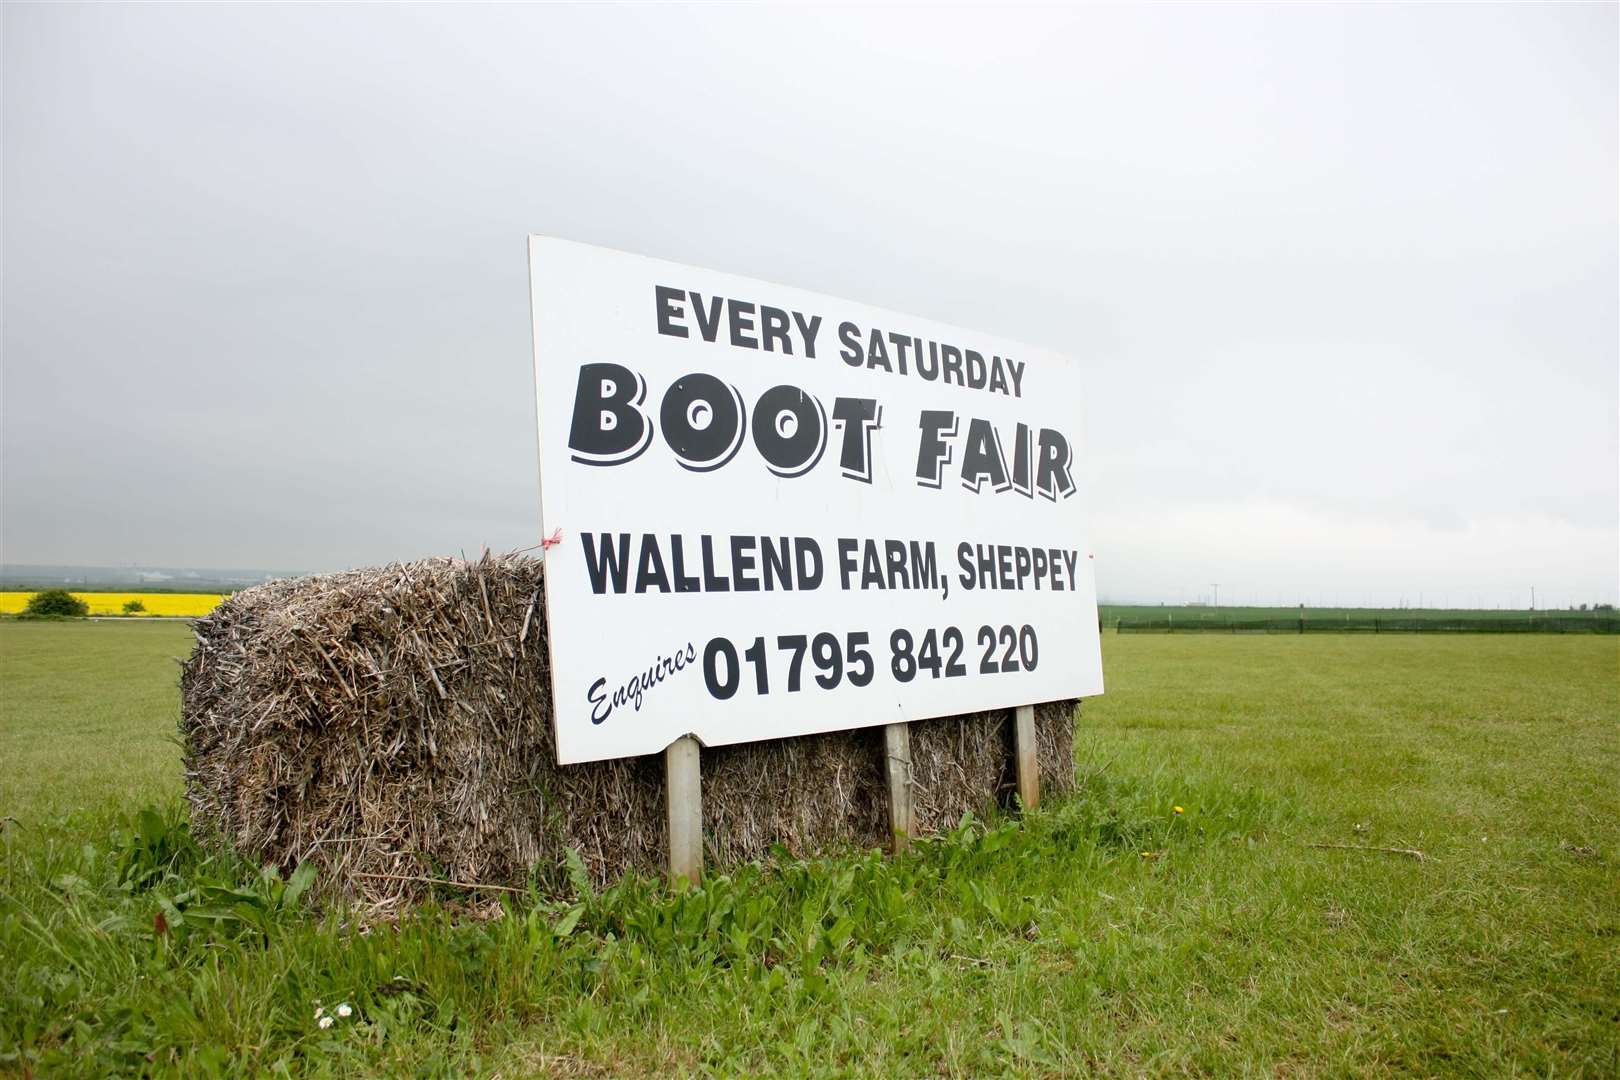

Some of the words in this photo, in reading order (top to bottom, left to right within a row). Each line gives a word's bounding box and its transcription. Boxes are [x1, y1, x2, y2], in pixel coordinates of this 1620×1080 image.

[656, 286, 822, 359] EVERY
[839, 322, 1025, 398] SATURDAY
[568, 363, 882, 484] BOOT
[916, 411, 1077, 503] FAIR
[581, 533, 824, 595] WALLEND
[838, 539, 948, 601] FARM,
[958, 542, 1078, 592] SHEPPEY
[587, 641, 698, 726] Enquires
[703, 632, 875, 701] 01795
[890, 629, 967, 683] 842
[977, 624, 1039, 675] 220
